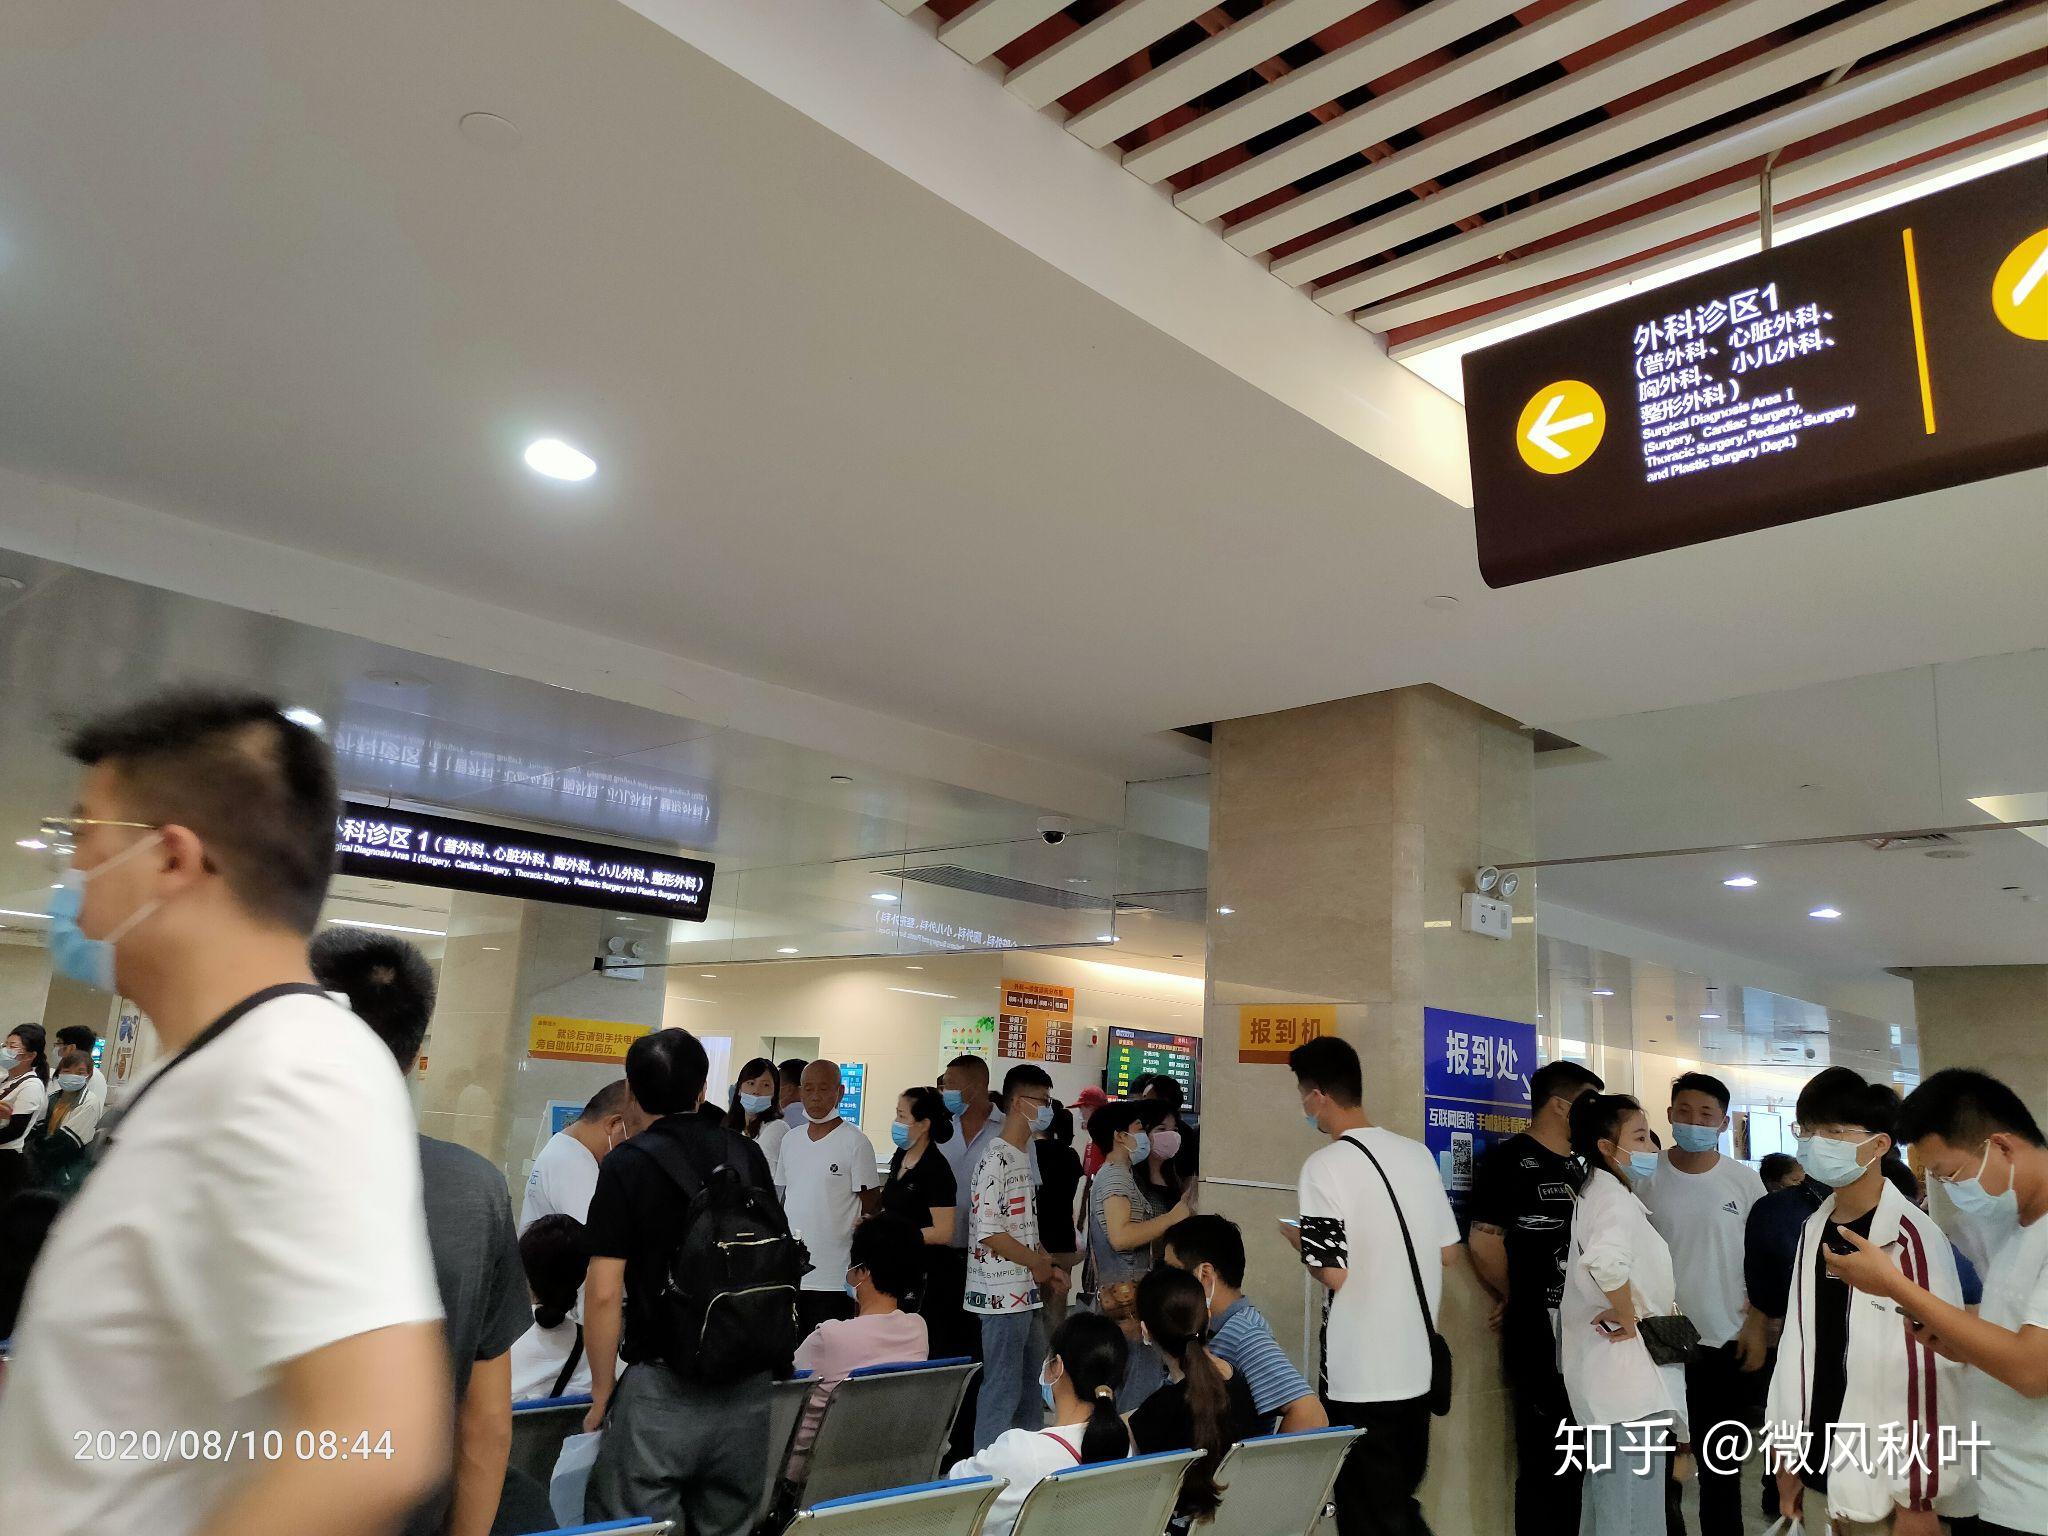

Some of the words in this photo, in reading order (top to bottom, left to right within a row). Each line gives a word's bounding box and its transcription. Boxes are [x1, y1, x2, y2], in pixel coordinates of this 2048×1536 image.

[1633, 282, 1779, 355] 外科诊区1
[1642, 418, 1690, 440] Surgical
[1690, 402, 1750, 429] Diagnosis
[1751, 393, 1782, 411] Area
[1644, 433, 1696, 455] (Surgery,
[1702, 418, 1747, 438] Cardiac
[1749, 403, 1803, 425] Surgery,
[1645, 447, 1696, 468] Thoracic
[1803, 404, 1856, 428] Surgery
[1646, 467, 1668, 483] and
[1671, 458, 1710, 477] Plastic
[1711, 445, 1758, 466] Surgery
[353, 843, 390, 858] Diagnosis
[391, 851, 410, 861] Area
[455, 860, 482, 871] Cardiac
[514, 868, 543, 880] Thoracic
[573, 877, 601, 889] Pediatric
[1250, 1017, 1322, 1046] 报到机
[1446, 1029, 1519, 1082] 报到处
[1429, 1107, 1475, 1131] 互联网医院
